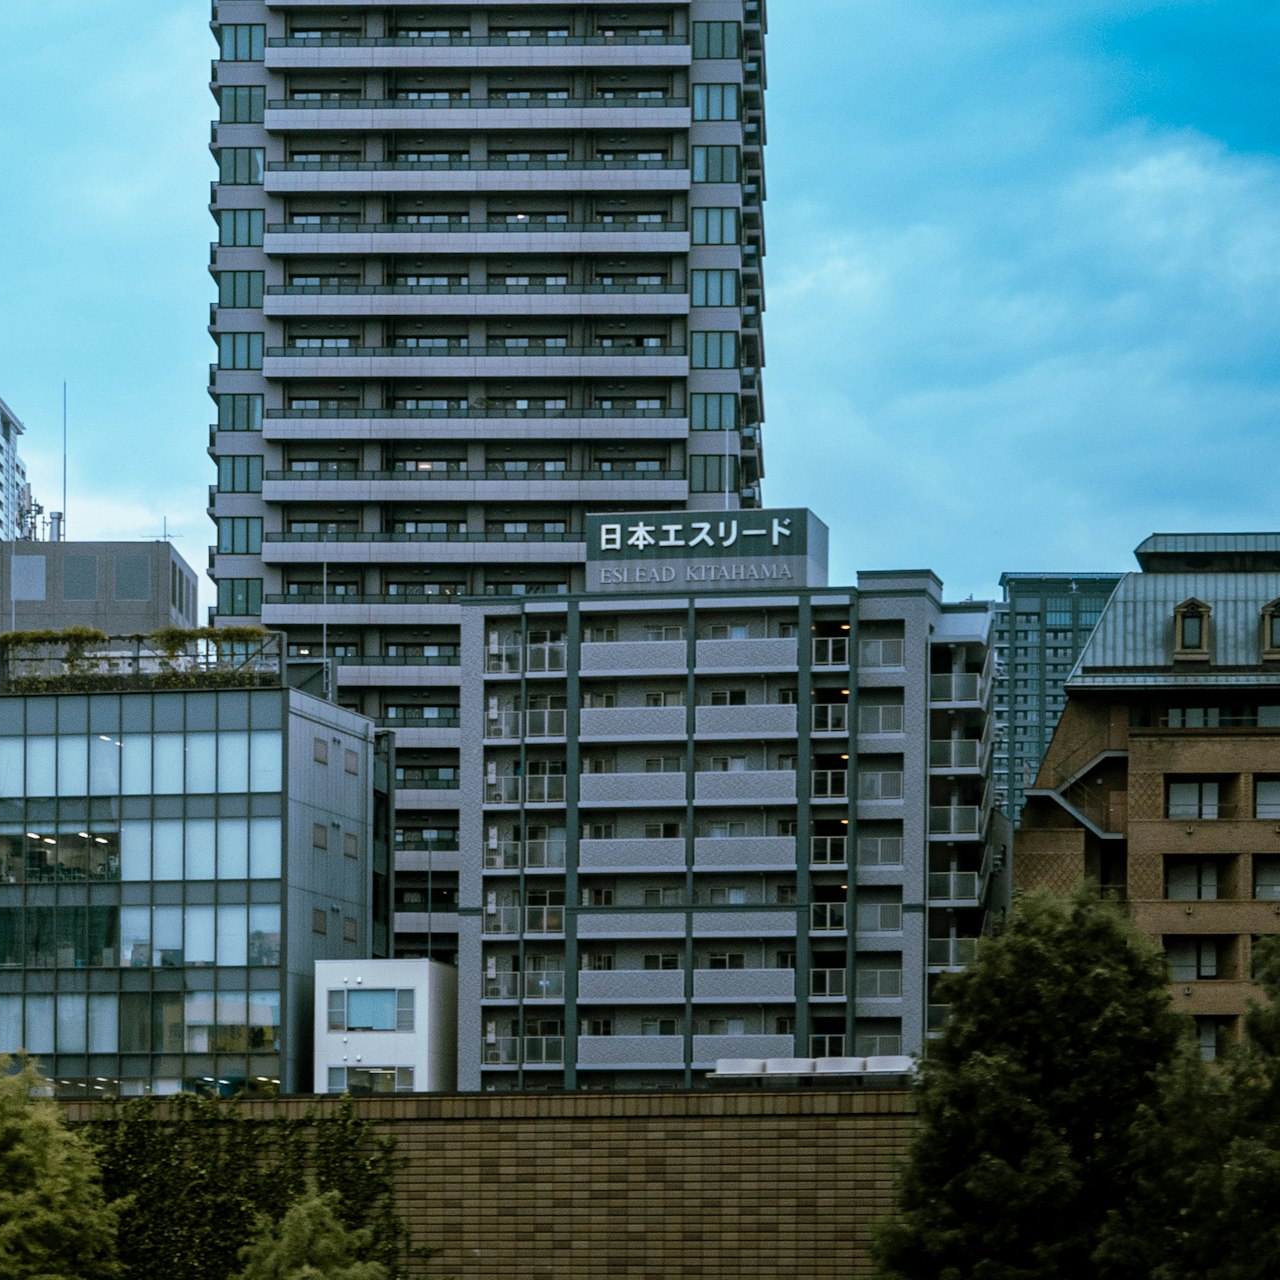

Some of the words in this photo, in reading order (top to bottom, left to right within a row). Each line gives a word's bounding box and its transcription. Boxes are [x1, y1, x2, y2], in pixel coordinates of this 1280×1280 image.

[600, 518, 792, 550] 日本エスリード
[600, 566, 676, 584] ESLEAD
[685, 563, 793, 582] KITAHAMA
